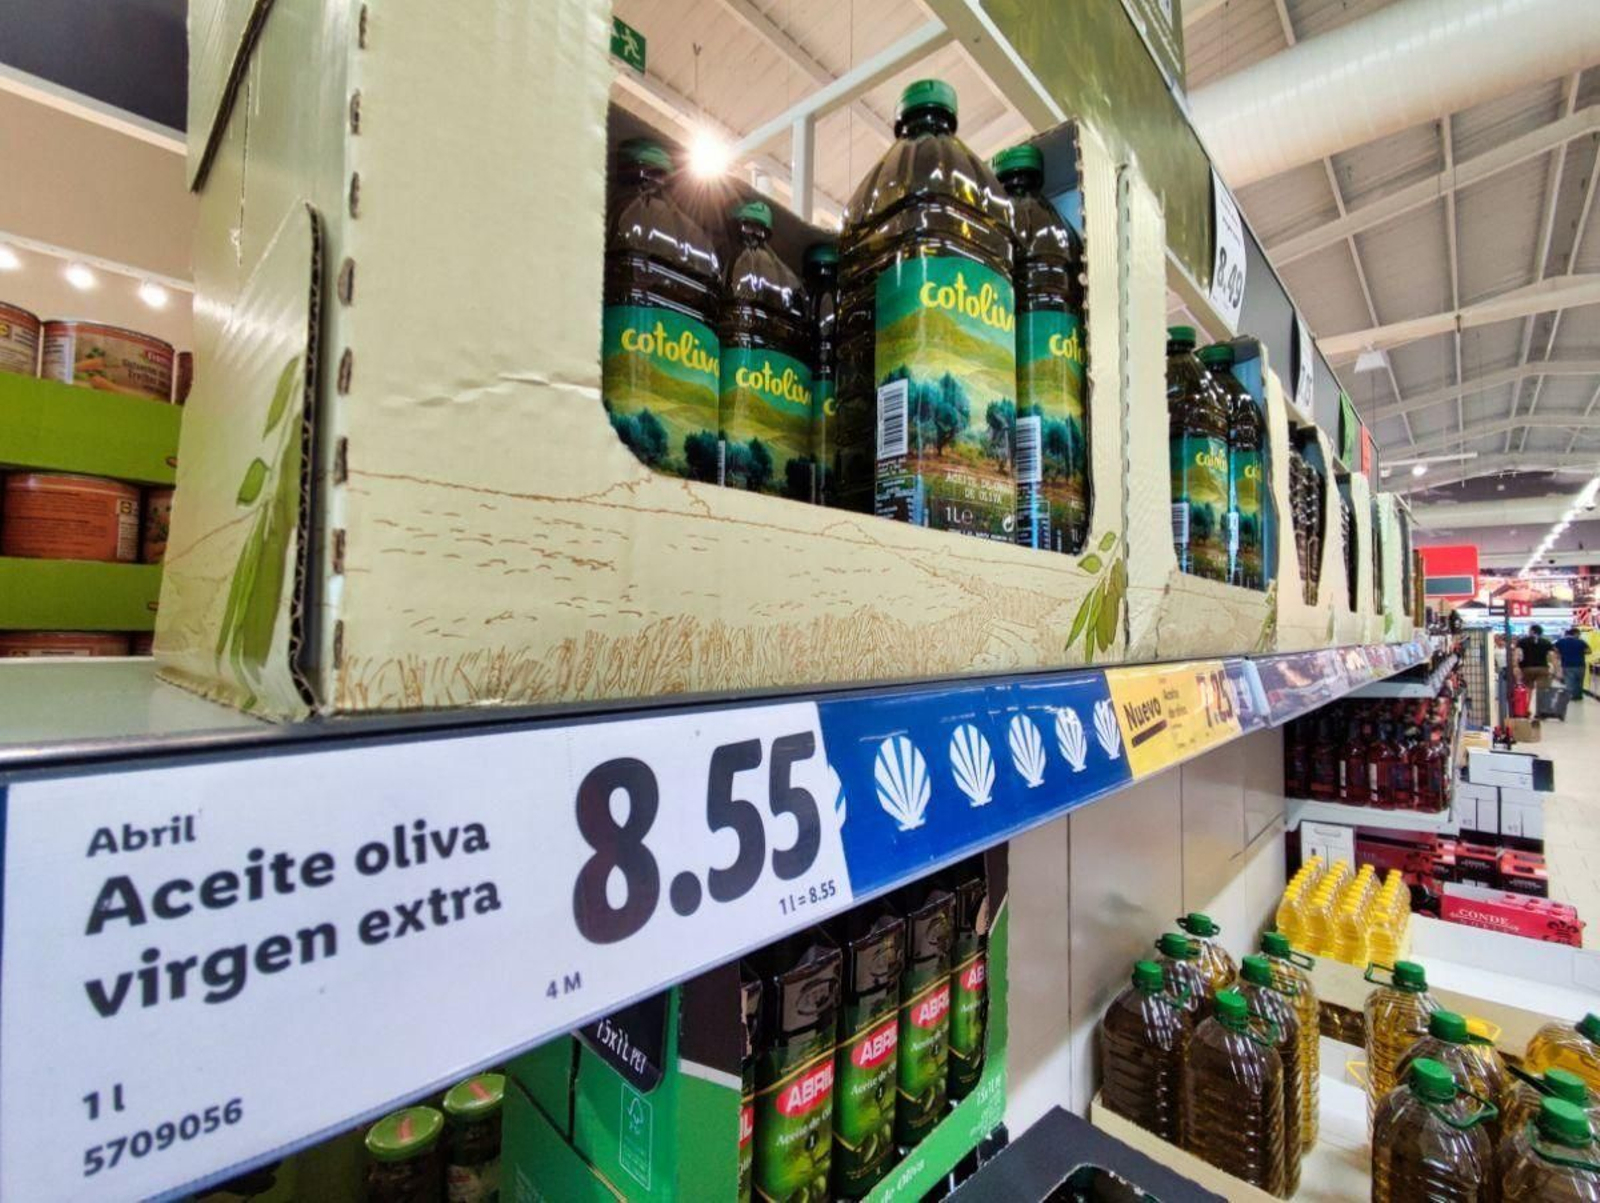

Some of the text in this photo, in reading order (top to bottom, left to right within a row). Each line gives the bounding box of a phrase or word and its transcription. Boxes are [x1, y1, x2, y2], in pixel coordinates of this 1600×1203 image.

[920, 272, 1013, 332] cotoliv
[1217, 246, 1244, 309] 8.49
[1123, 697, 1162, 731] Nuevo
[85, 814, 197, 858] Abril
[571, 729, 823, 945] 8.55
[83, 817, 490, 936] Aceite oliva
[809, 879, 836, 904] 8.55
[1458, 908, 1510, 926] CONDE
[83, 881, 503, 1020] virgen extra
[545, 970, 582, 999] 4 M
[82, 1090, 102, 1122] 1
[83, 1097, 244, 1177] 5709056
